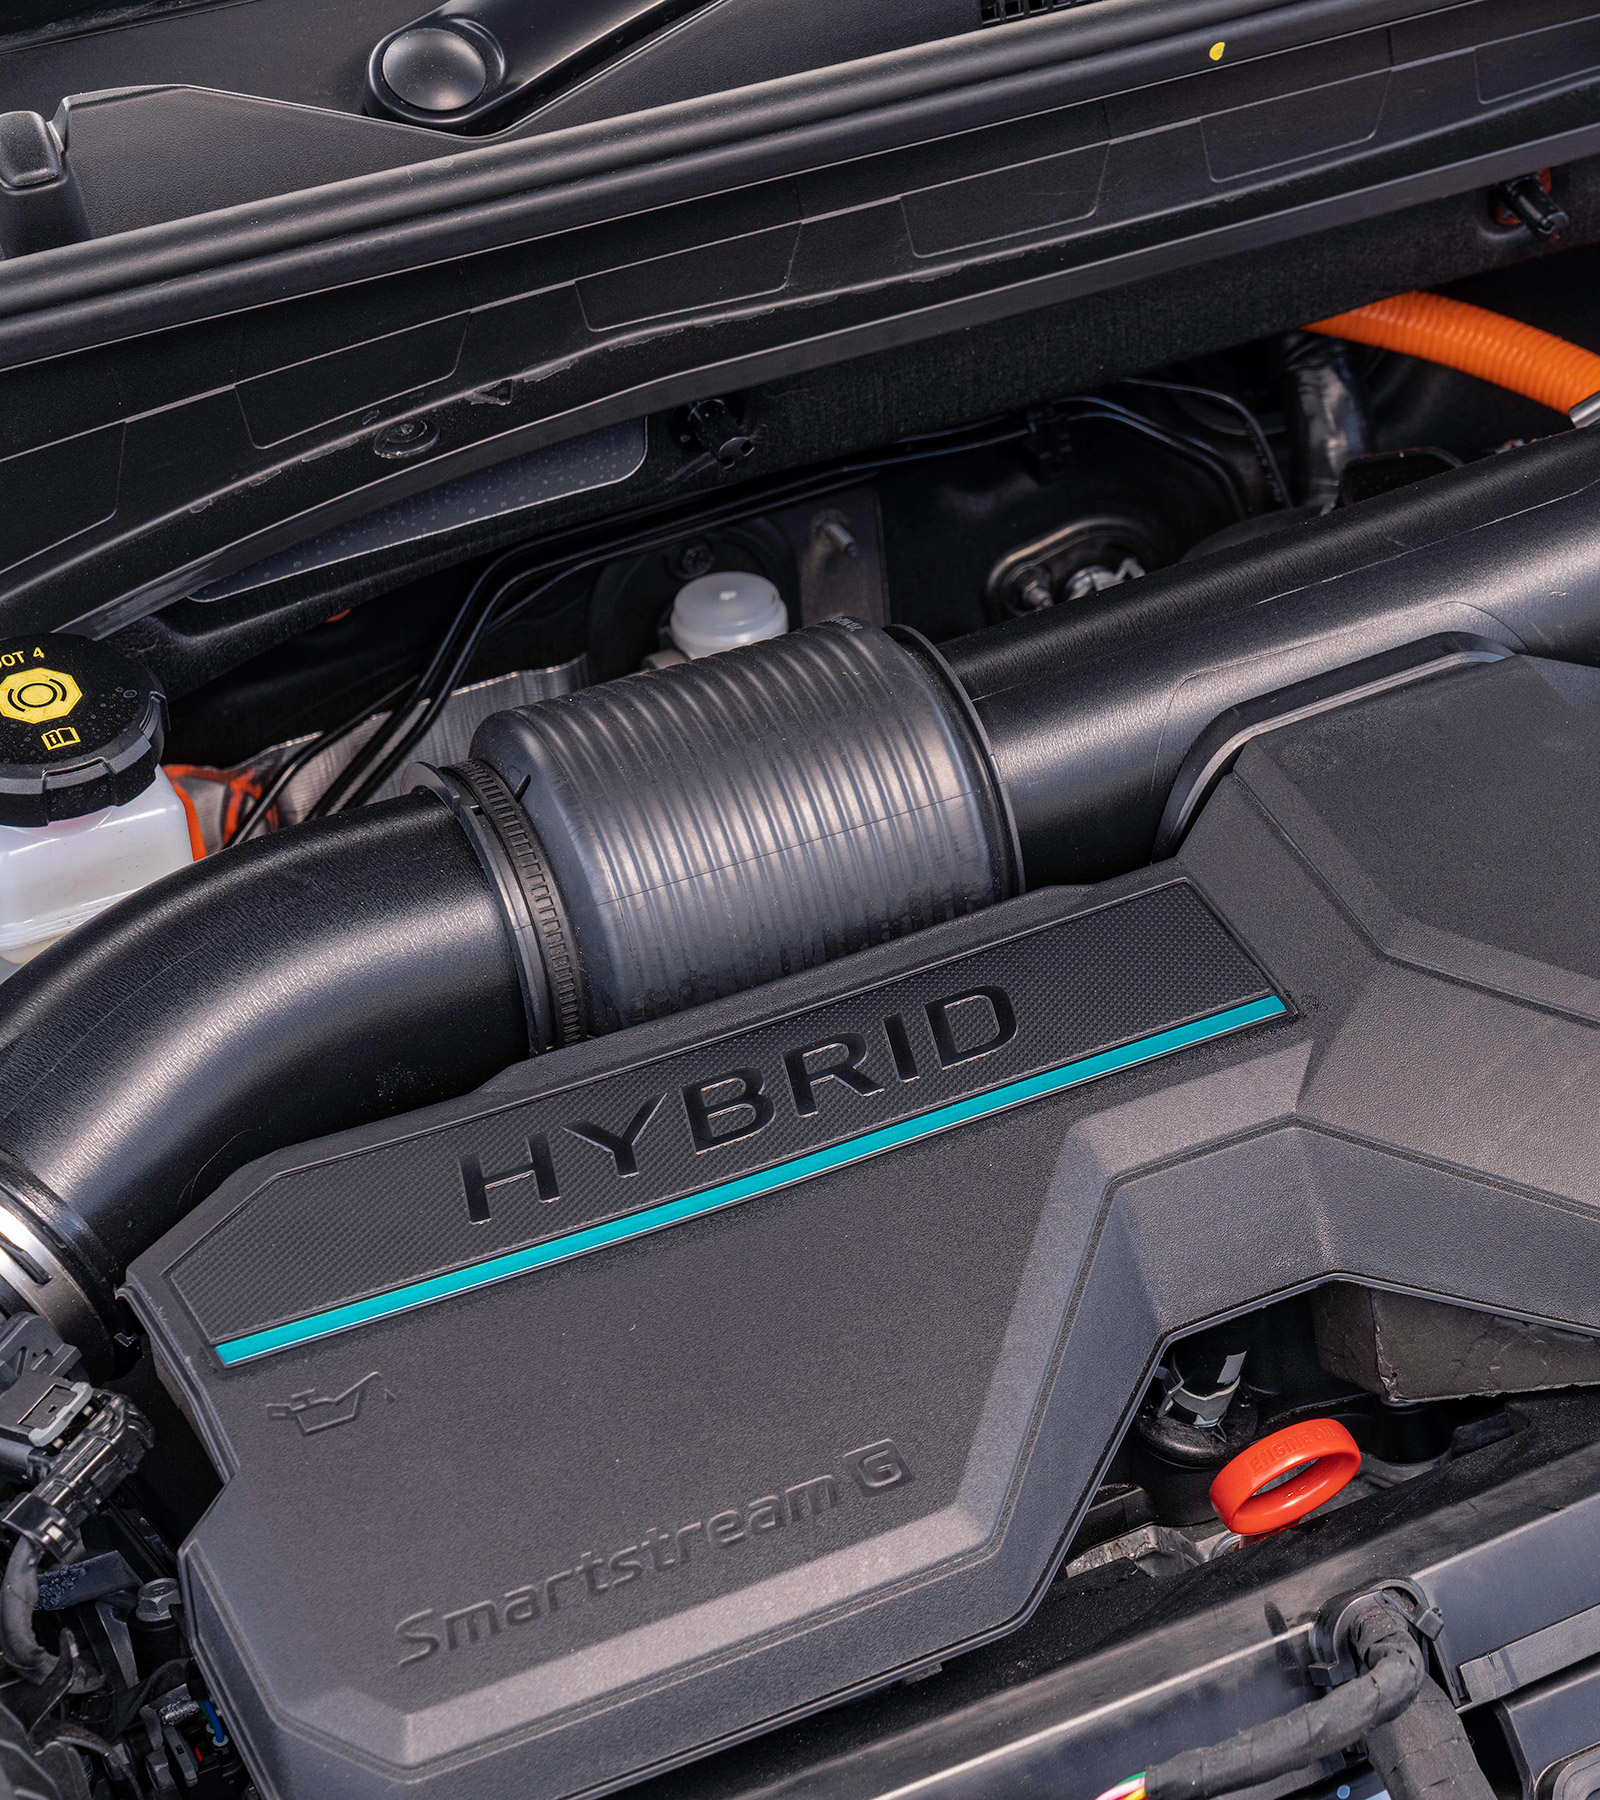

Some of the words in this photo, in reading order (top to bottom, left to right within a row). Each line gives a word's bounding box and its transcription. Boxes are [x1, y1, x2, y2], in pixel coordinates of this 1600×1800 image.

[0, 651, 25, 669] OT
[33, 647, 45, 659] 4
[457, 985, 1018, 1224] HYBRID
[1247, 1429, 1313, 1475] ENGINE
[395, 1473, 842, 1665] Smartstream
[852, 1444, 907, 1491] G
